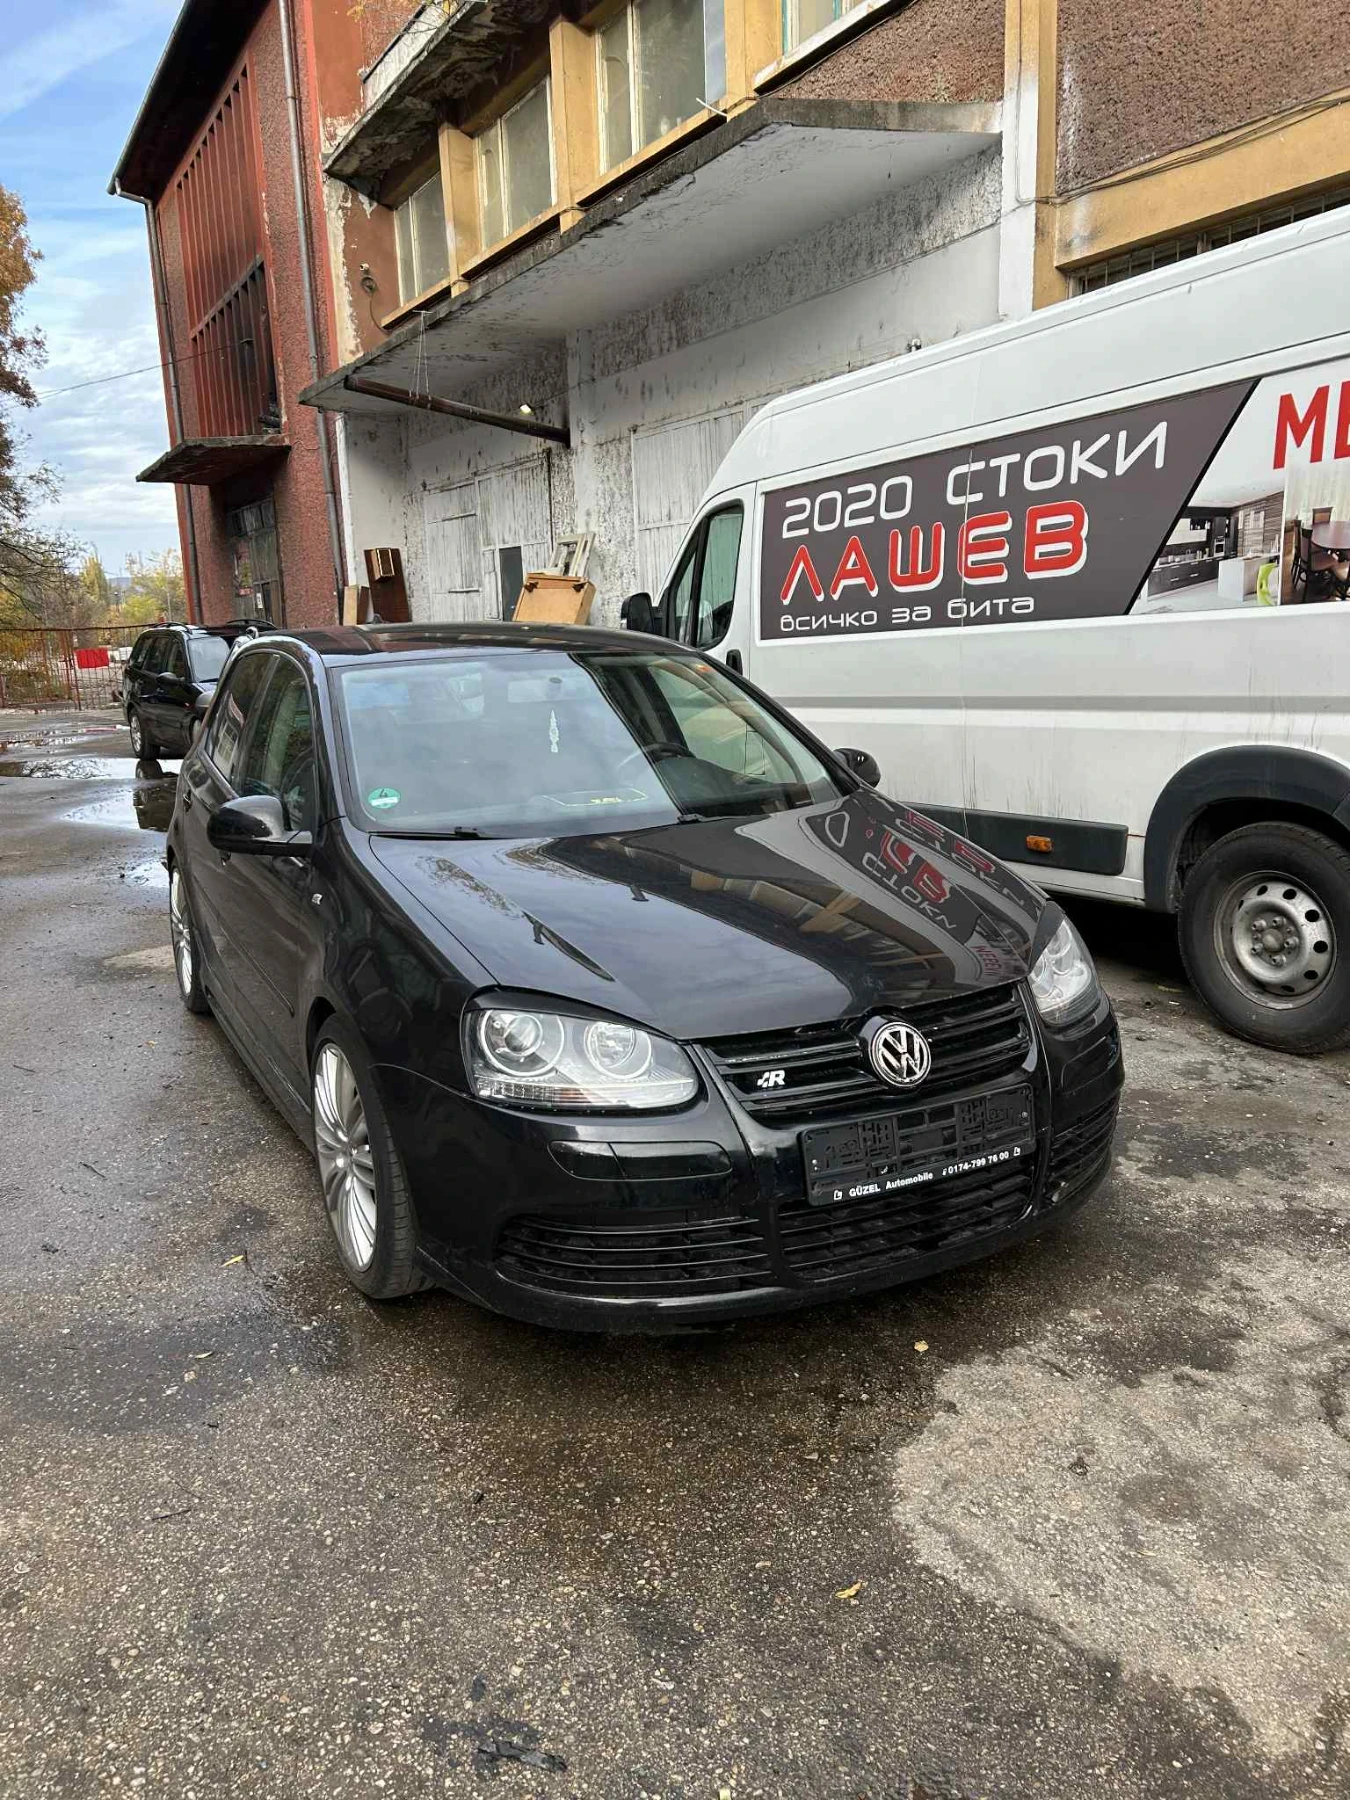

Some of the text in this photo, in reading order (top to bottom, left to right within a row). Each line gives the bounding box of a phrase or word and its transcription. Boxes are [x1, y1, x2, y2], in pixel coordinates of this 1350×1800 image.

[1273, 381, 1350, 470] М
[782, 421, 1168, 538] 2020 СТОКИ
[780, 500, 1089, 605] ЛАШЕВ
[780, 595, 1035, 632] всичко за бита
[849, 1184, 881, 1198] GÜZEL
[885, 1171, 934, 1190] Automobile
